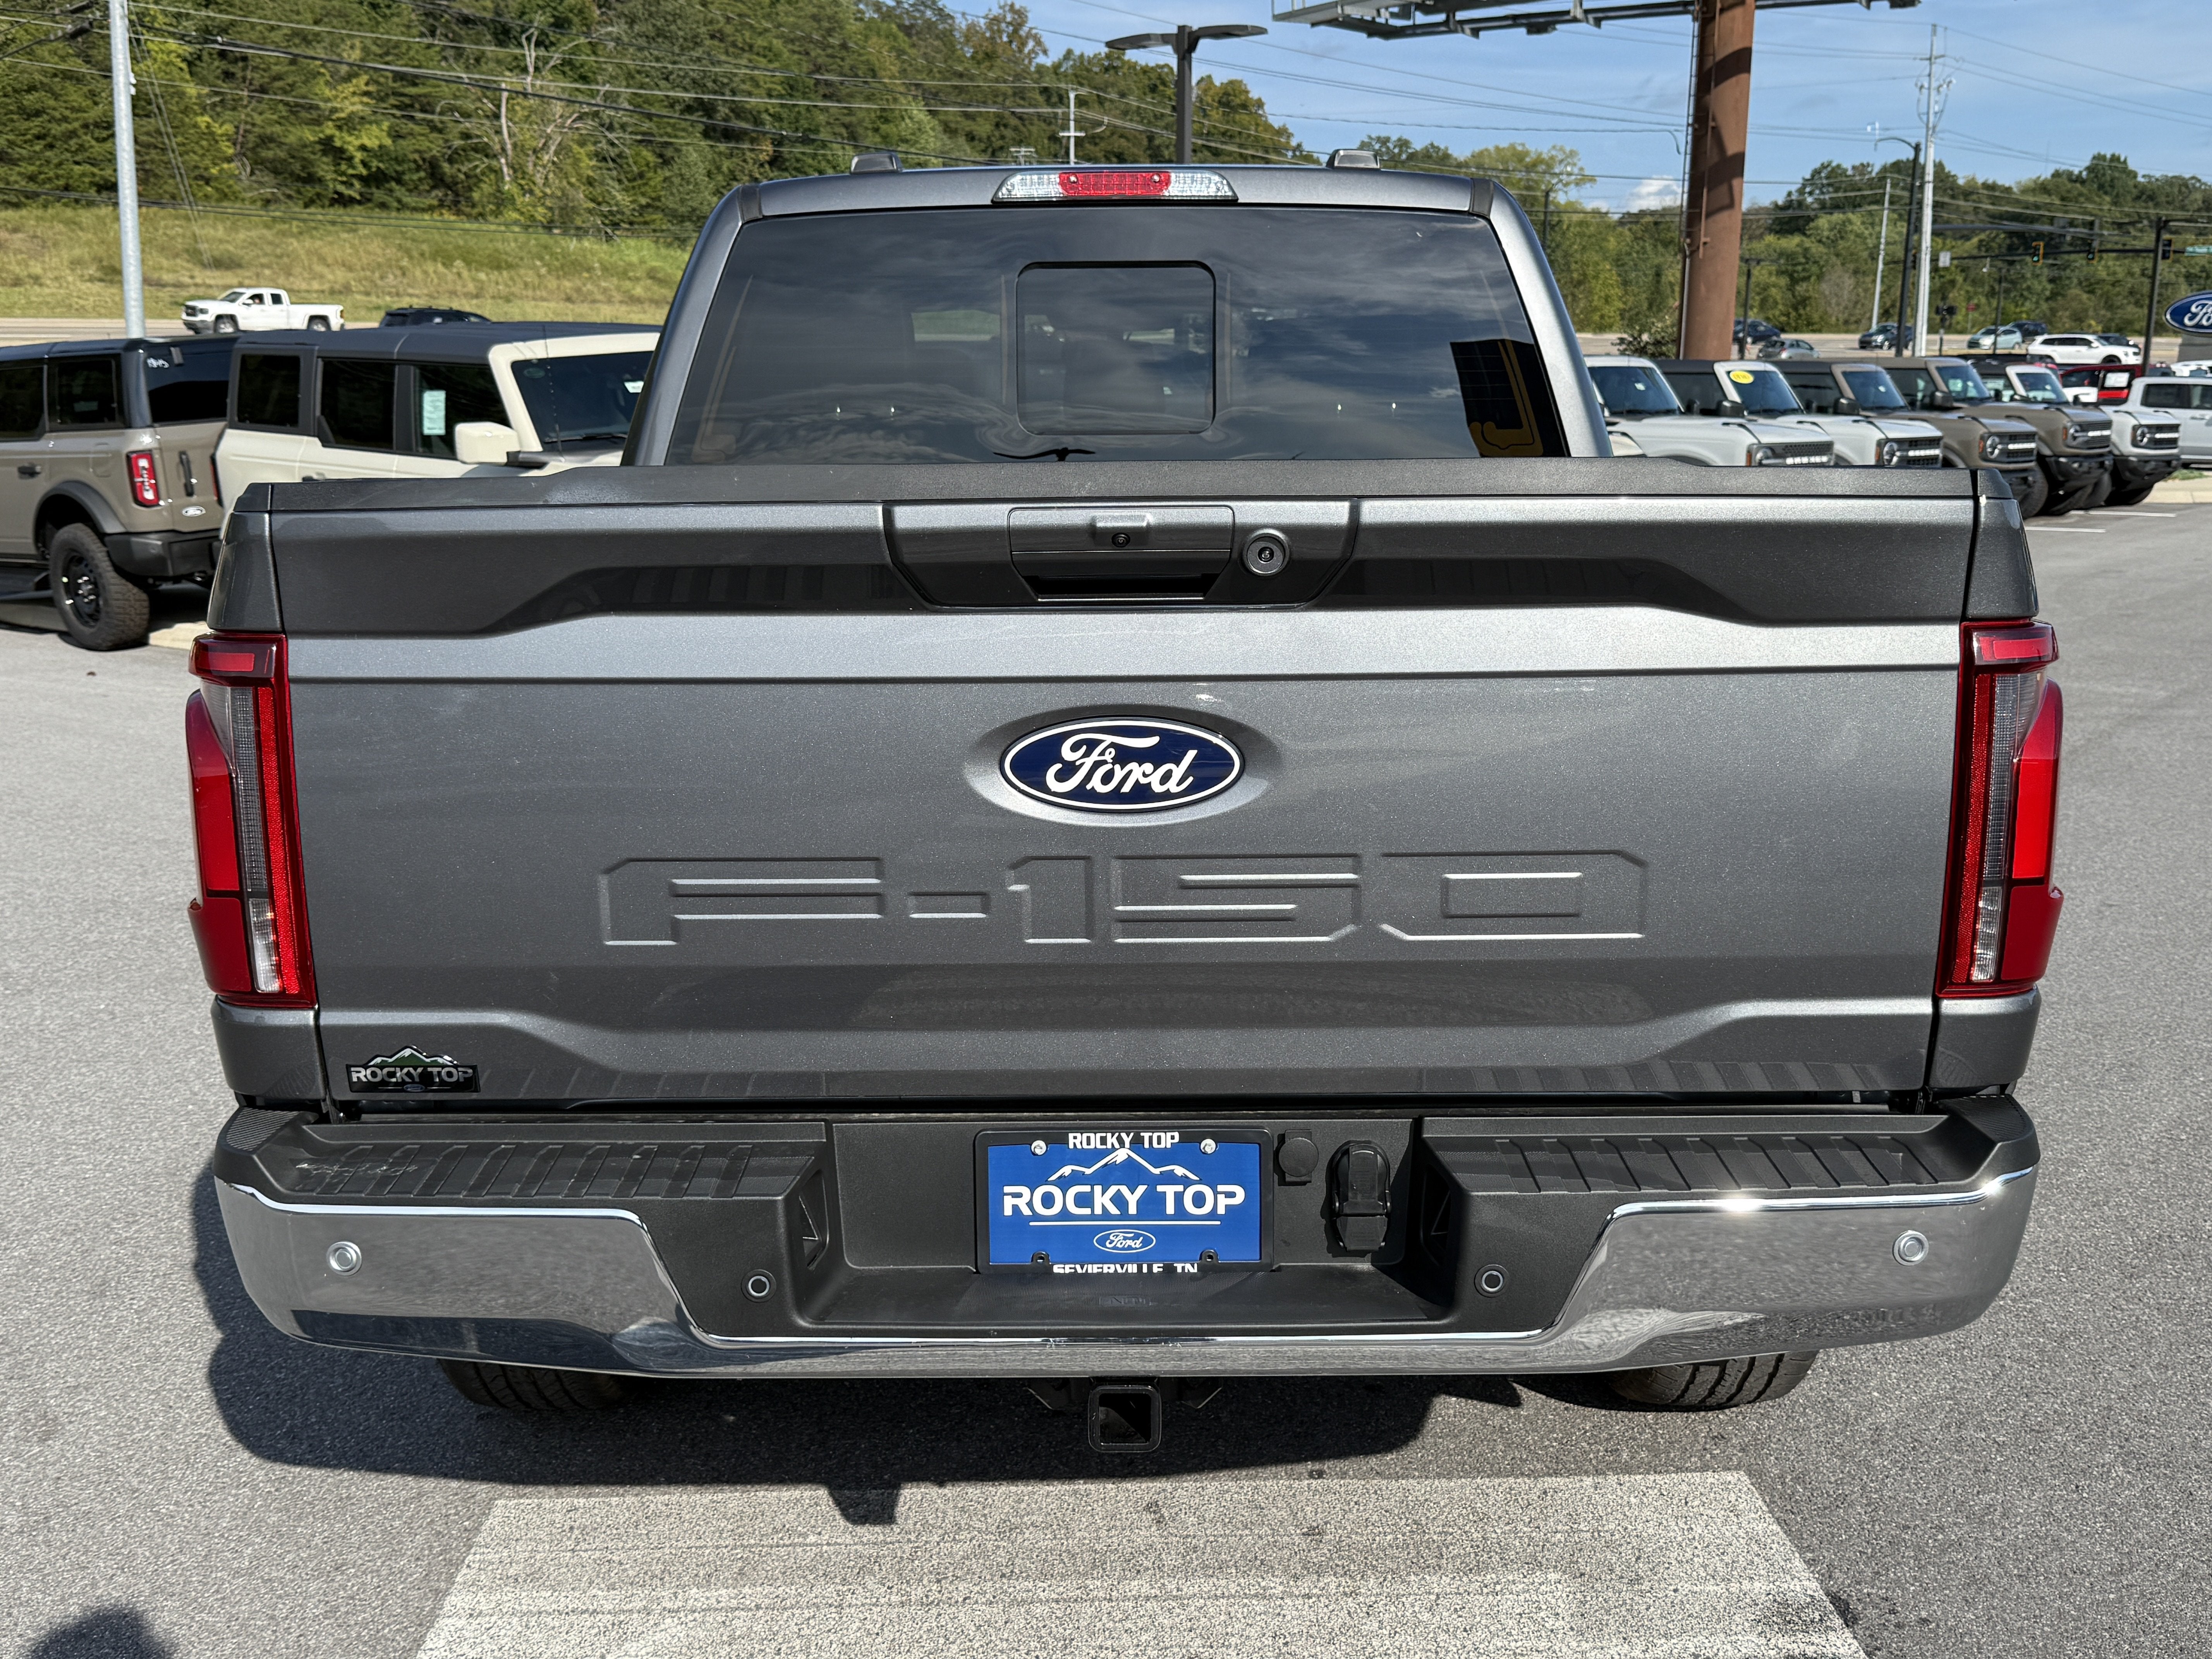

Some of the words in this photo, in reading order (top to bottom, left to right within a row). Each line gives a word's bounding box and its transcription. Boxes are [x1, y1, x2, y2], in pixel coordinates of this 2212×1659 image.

[1046, 733, 1198, 793] Ford
[598, 850, 1648, 945] F-150
[350, 1067, 423, 1082] ROCKY
[427, 1067, 473, 1082] TOP
[1068, 1132, 1134, 1149] ROCKY
[1140, 1132, 1179, 1149] TOP
[1003, 1184, 1148, 1216] ROCKY
[1156, 1184, 1246, 1216] TOP
[1106, 1233, 1143, 1248] Ford
[1173, 1263, 1197, 1273] TN
